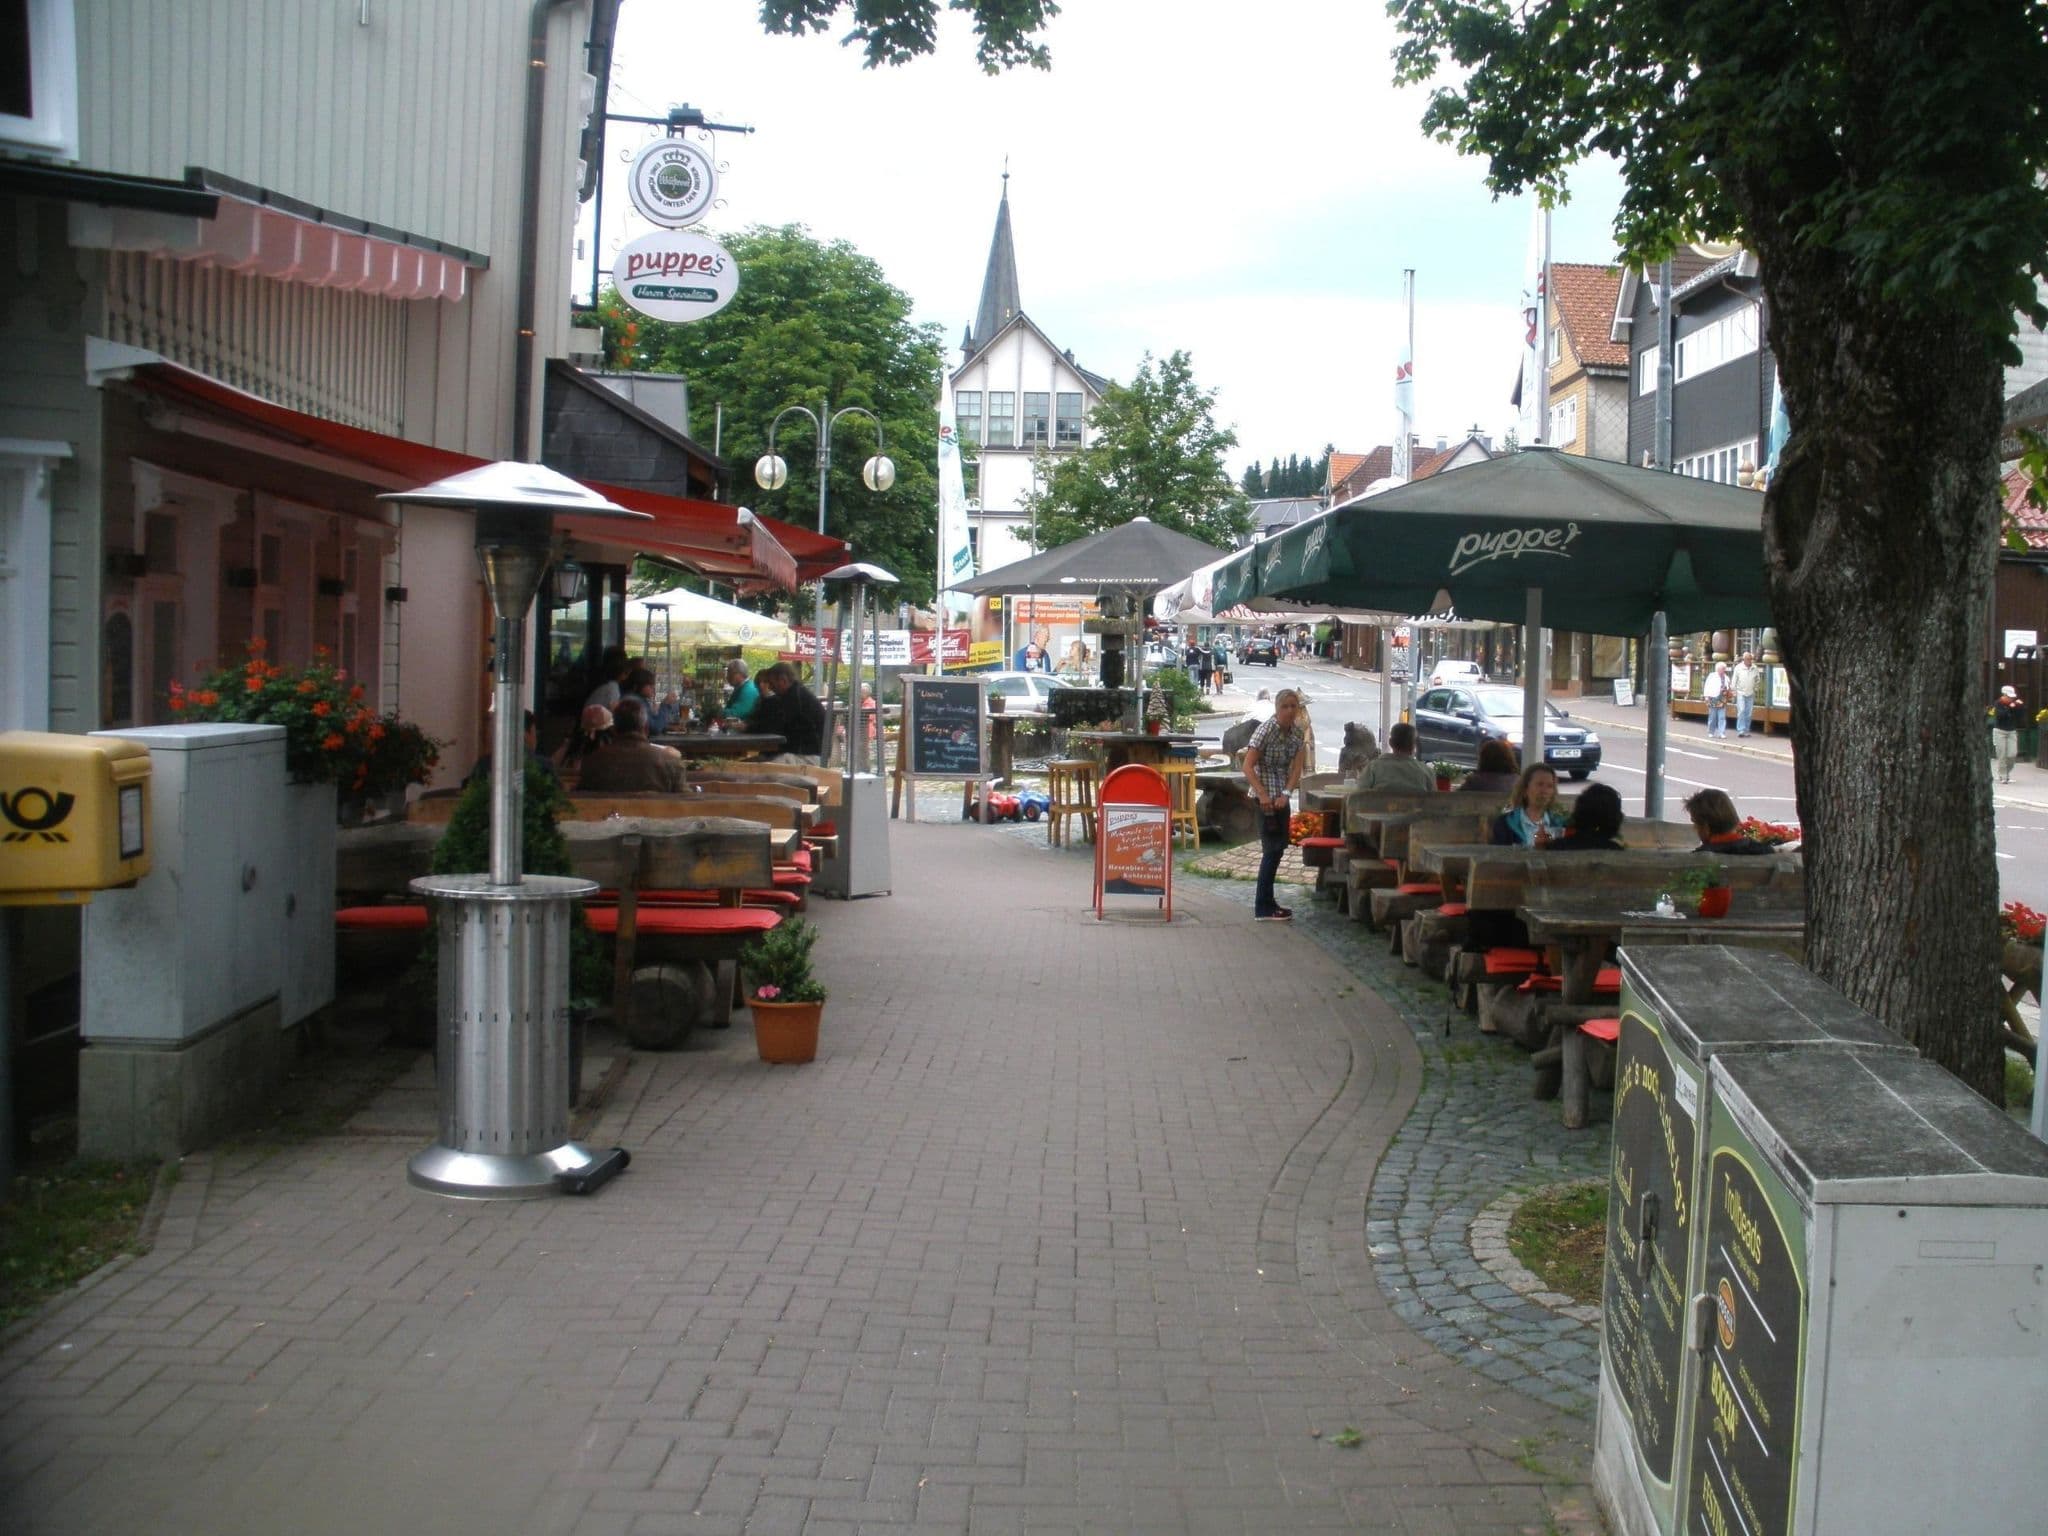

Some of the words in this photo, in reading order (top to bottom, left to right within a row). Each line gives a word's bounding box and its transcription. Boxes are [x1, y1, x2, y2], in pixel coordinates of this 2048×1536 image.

[662, 199, 687, 208] UNTER
[627, 252, 726, 279] puppe's
[1724, 1171, 1762, 1266] Trollbeads
